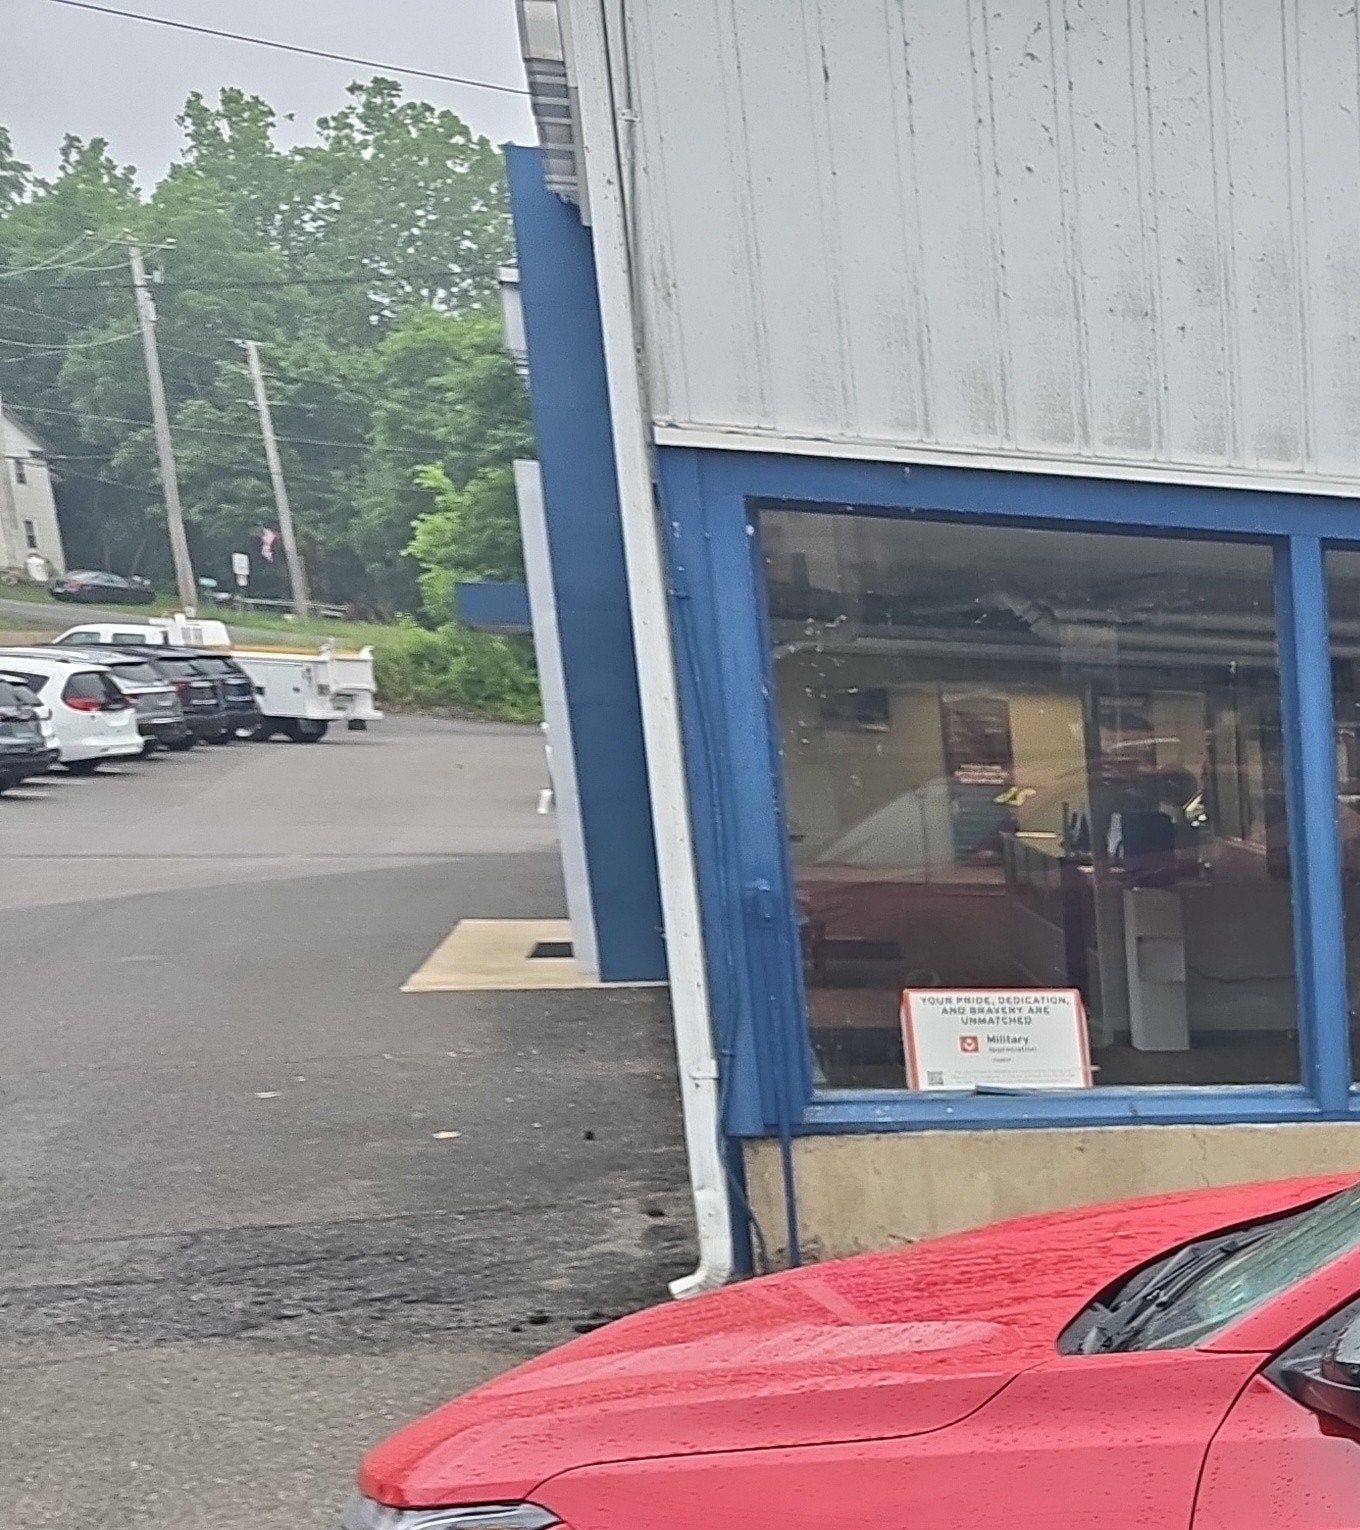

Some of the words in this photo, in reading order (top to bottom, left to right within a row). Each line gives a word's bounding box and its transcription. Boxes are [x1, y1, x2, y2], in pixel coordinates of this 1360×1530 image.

[920, 996, 953, 1005] YOUR
[956, 996, 995, 1006] PRIDE,
[998, 996, 1070, 1006] DEDICATION,
[941, 1006, 966, 1015] AND
[969, 1006, 1023, 1015] BRAVERY
[1027, 1006, 1050, 1015] ARE
[961, 1016, 1032, 1025] UNMATCHED
[986, 1034, 1029, 1045] Military
